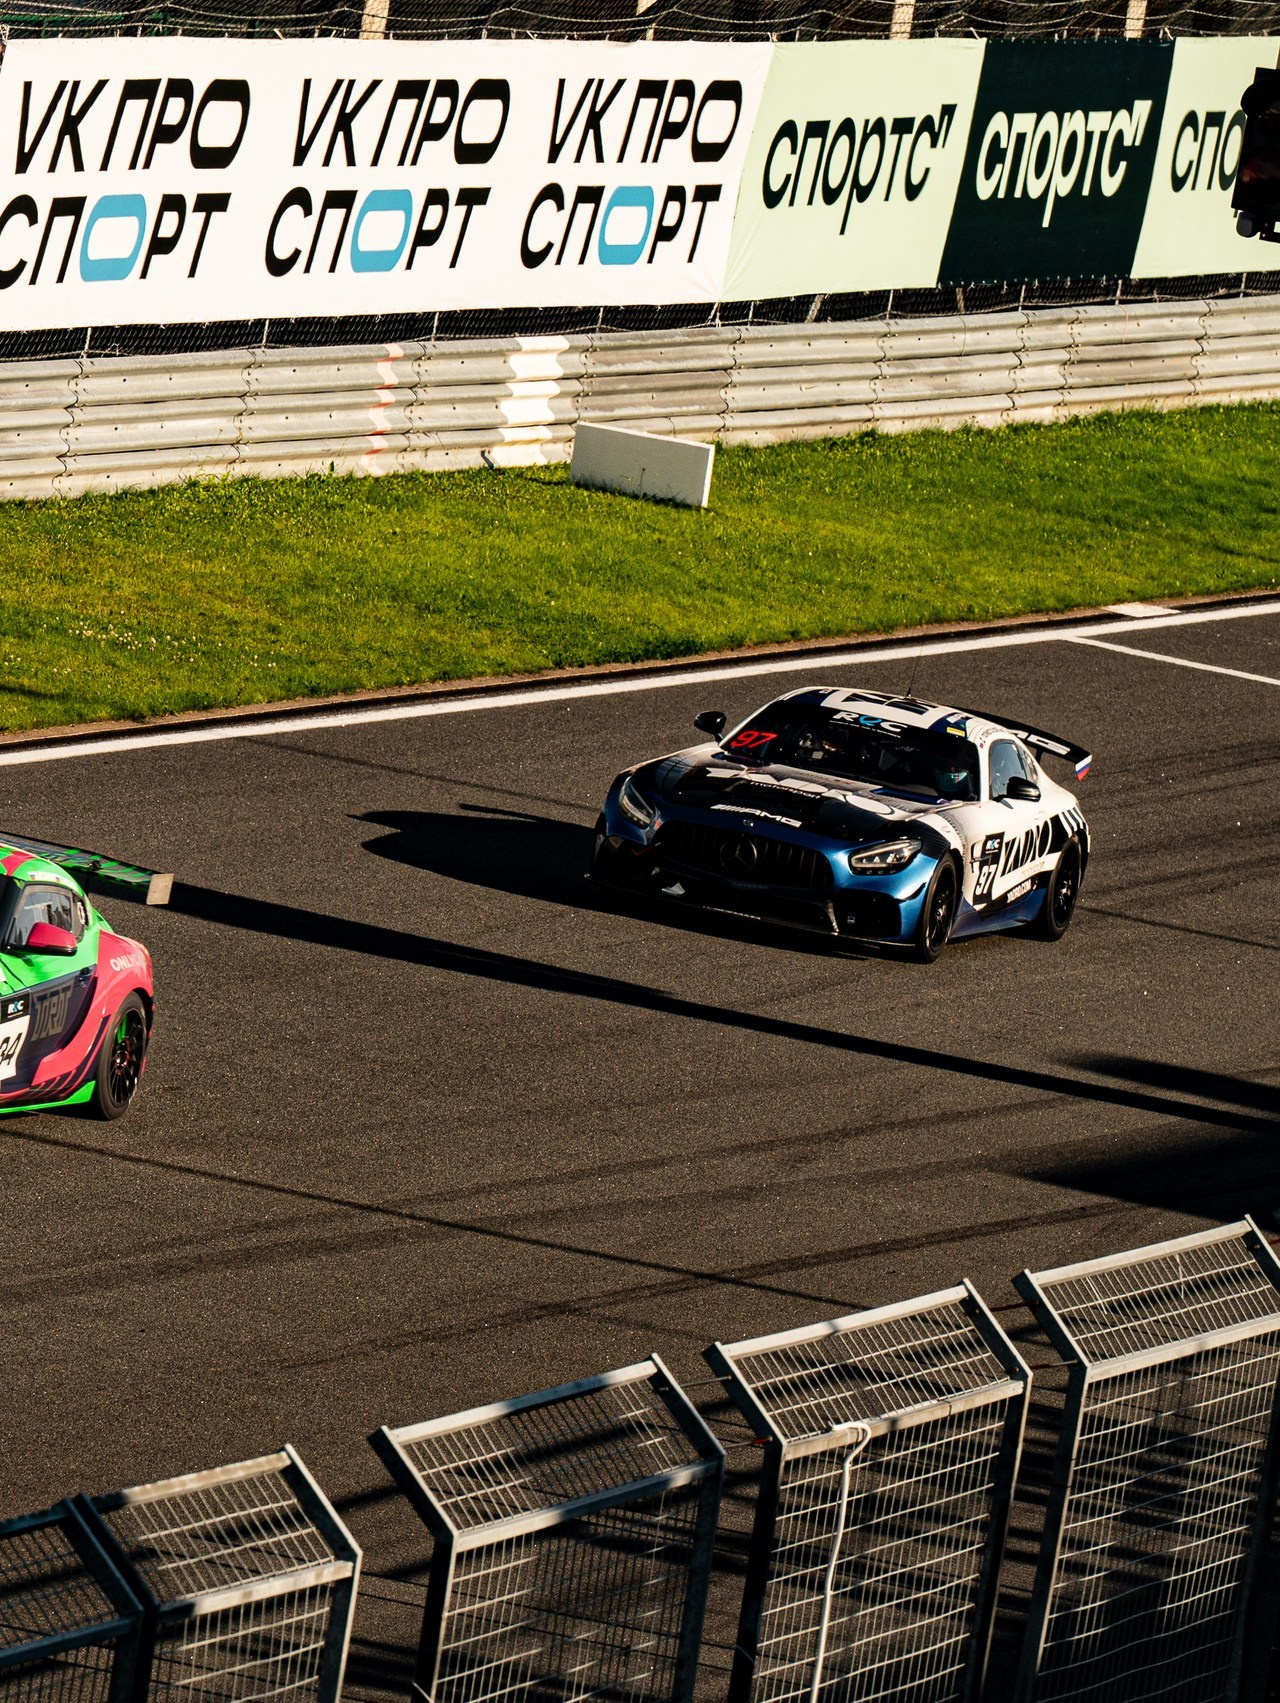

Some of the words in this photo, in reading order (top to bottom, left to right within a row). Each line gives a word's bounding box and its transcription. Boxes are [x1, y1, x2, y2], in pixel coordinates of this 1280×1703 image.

[15, 78, 109, 174] VK
[100, 78, 251, 170] ПРО
[293, 78, 383, 167] VK
[370, 78, 511, 165] ПРО
[548, 78, 627, 164] VK
[616, 79, 743, 163] ПРО
[265, 186, 491, 278] СПОРТ
[520, 183, 723, 269] СПОРТ
[731, 730, 778, 748] 97
[975, 864, 997, 895] 97
